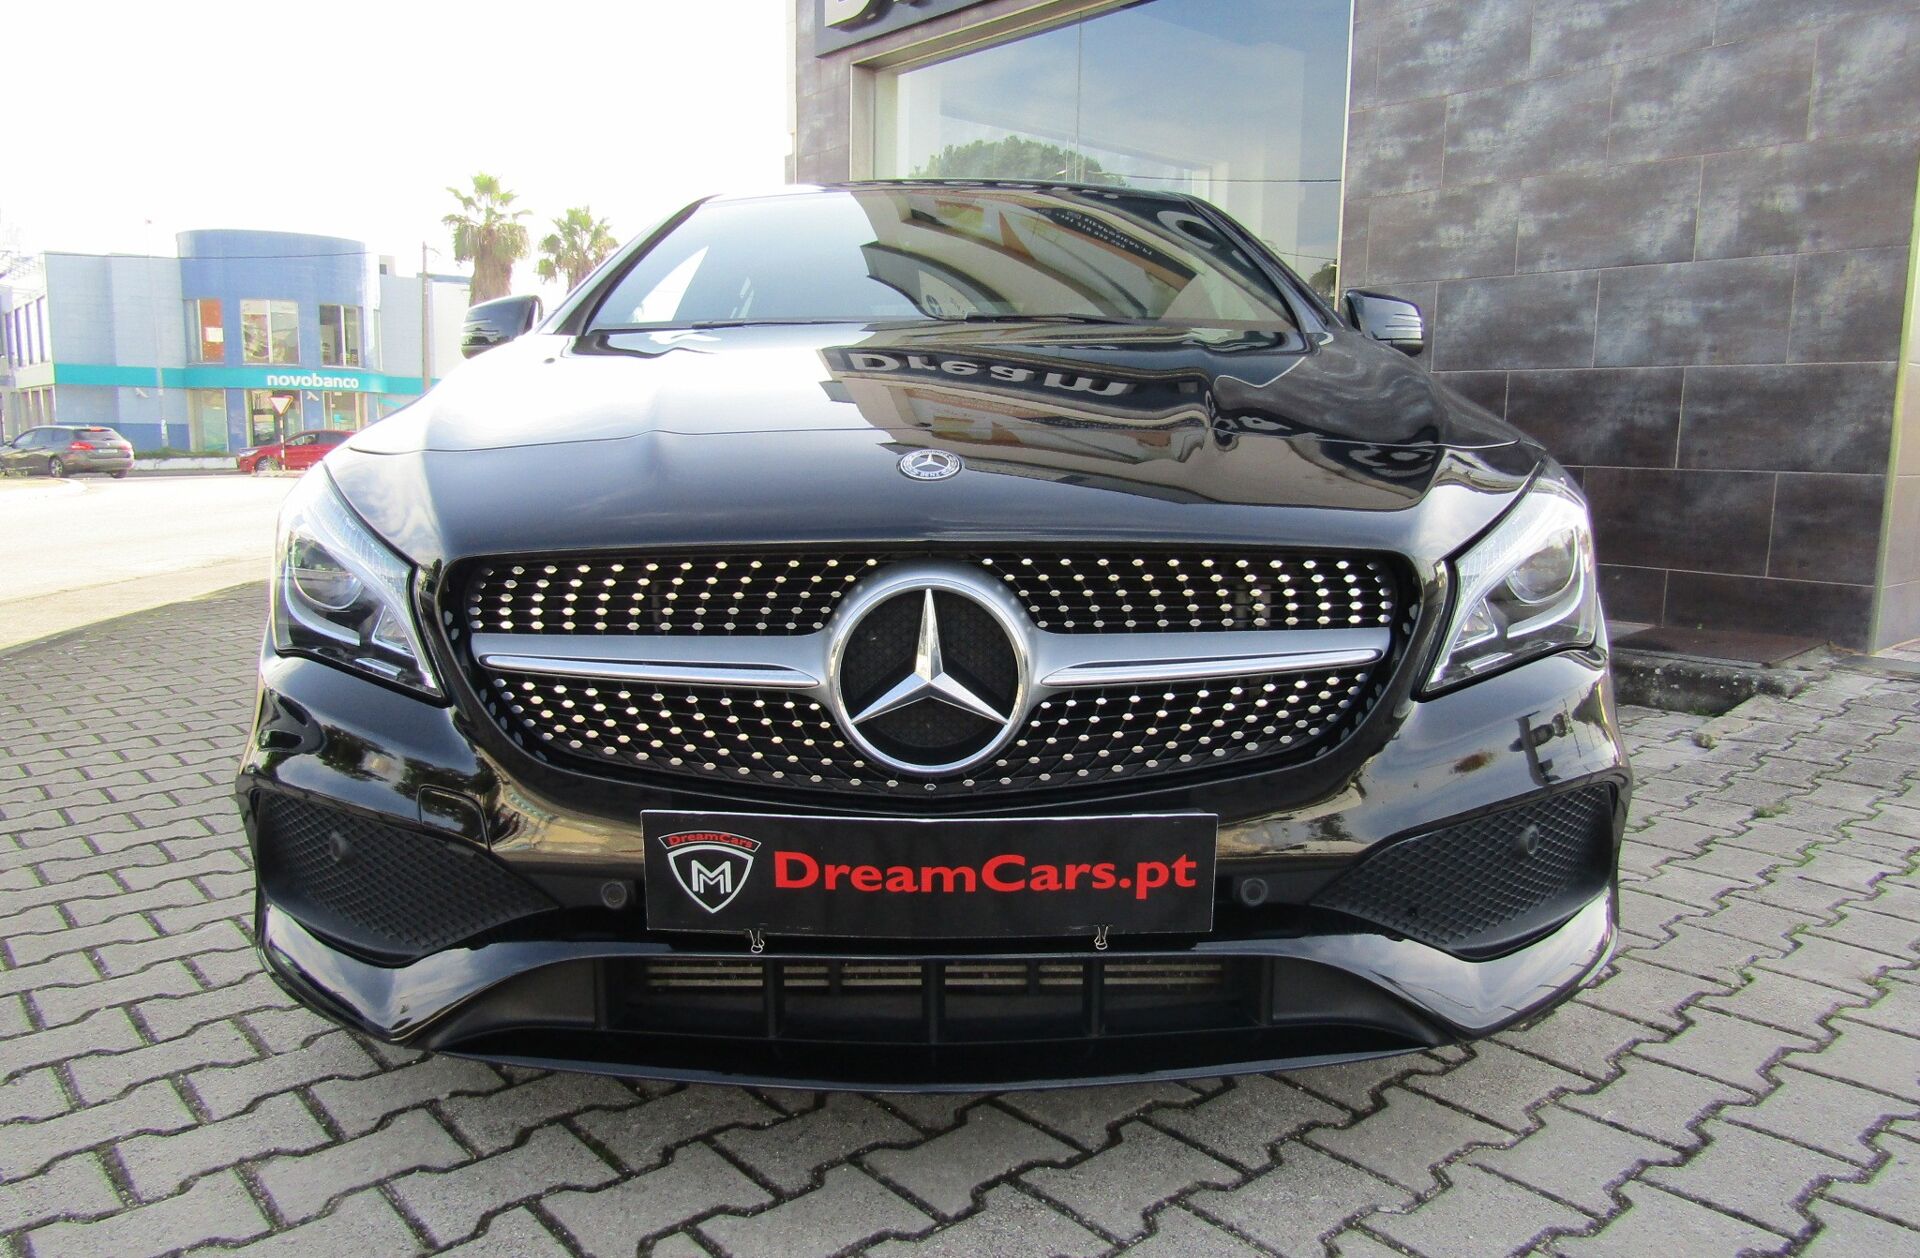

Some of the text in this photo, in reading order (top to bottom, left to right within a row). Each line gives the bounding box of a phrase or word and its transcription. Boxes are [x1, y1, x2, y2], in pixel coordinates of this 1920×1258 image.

[267, 373, 359, 389] novobanco
[668, 833, 753, 848] DreamCars
[774, 851, 1197, 900] DreamCars.pt
